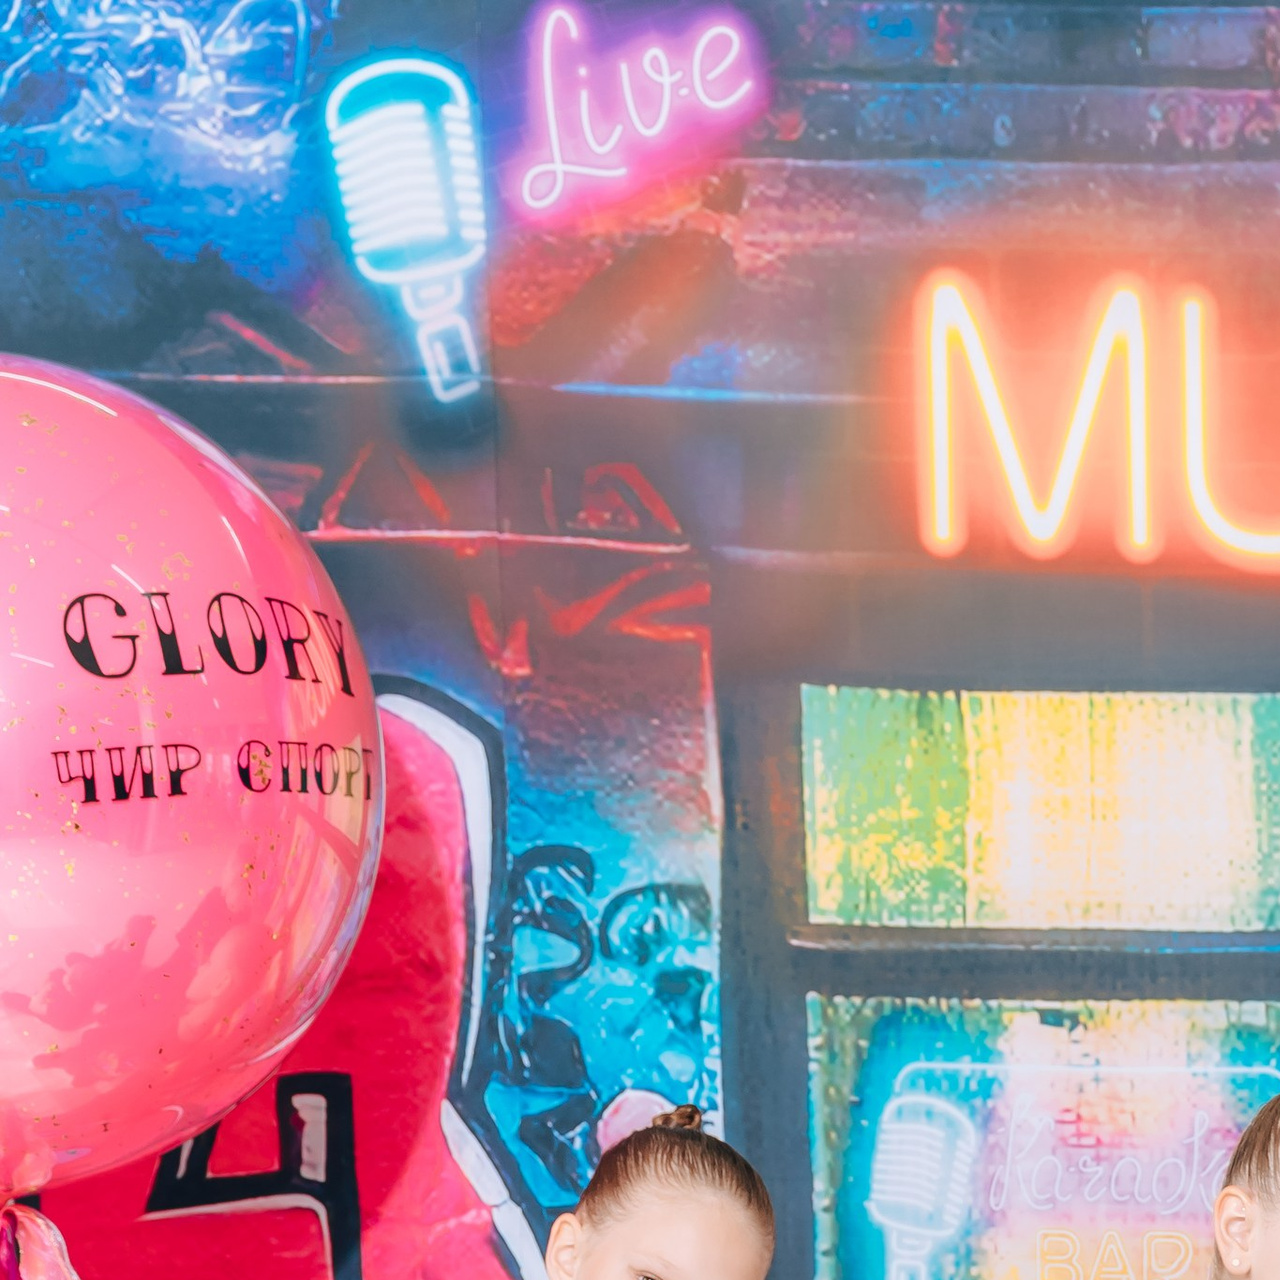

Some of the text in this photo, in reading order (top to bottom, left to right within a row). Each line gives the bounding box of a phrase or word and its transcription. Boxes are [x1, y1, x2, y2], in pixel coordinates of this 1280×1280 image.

[521, 3, 753, 210] Live
[62, 591, 355, 698] GLORY
[50, 744, 202, 804] ЧИР
